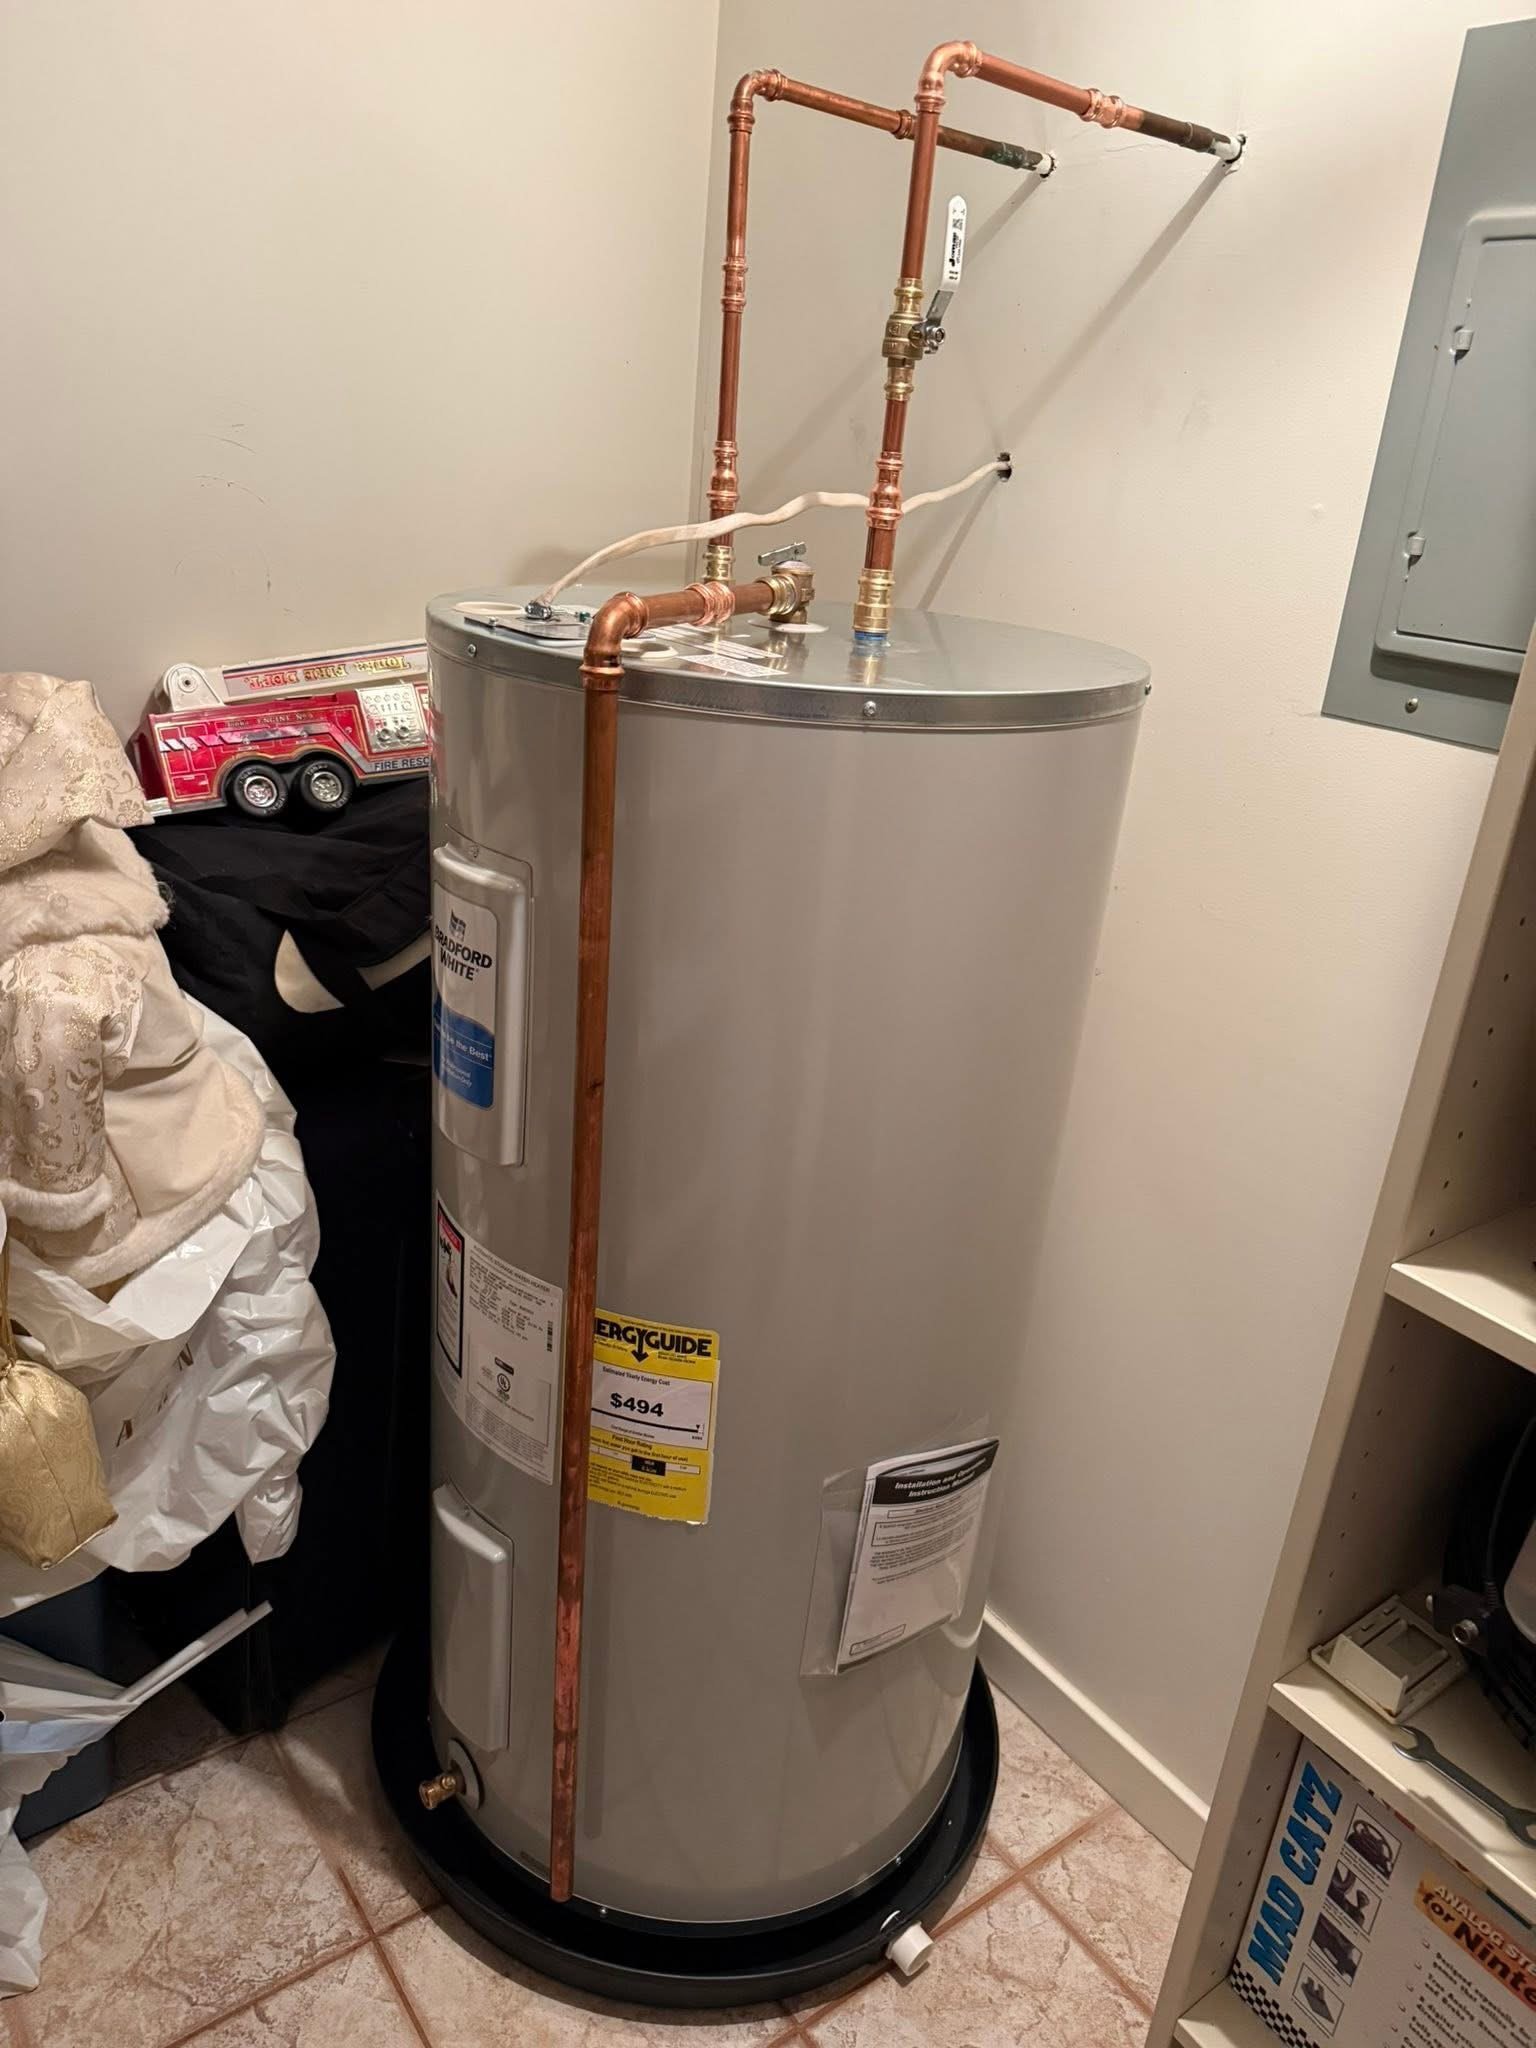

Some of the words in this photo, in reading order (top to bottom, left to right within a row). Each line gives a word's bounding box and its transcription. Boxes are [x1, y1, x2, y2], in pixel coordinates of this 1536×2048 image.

[304, 664, 347, 681] FIRE
[375, 761, 398, 771] FIRE
[402, 756, 430, 767] RESC
[434, 925, 492, 969] BRADFORD
[594, 1318, 712, 1358] ERGYGUIDE
[641, 1375, 657, 1385] Energy
[658, 1378, 670, 1386] Cost
[610, 1392, 664, 1417] $494
[894, 1479, 941, 1490] Installation
[1248, 1875, 1304, 1987] MAD
[1279, 1761, 1343, 1885] CATZ
[1435, 1886, 1505, 1949] ANALOG
[1505, 1943, 1536, 1977] STE
[1422, 1892, 1456, 1922] for
[1454, 1921, 1536, 2006] Ninte
